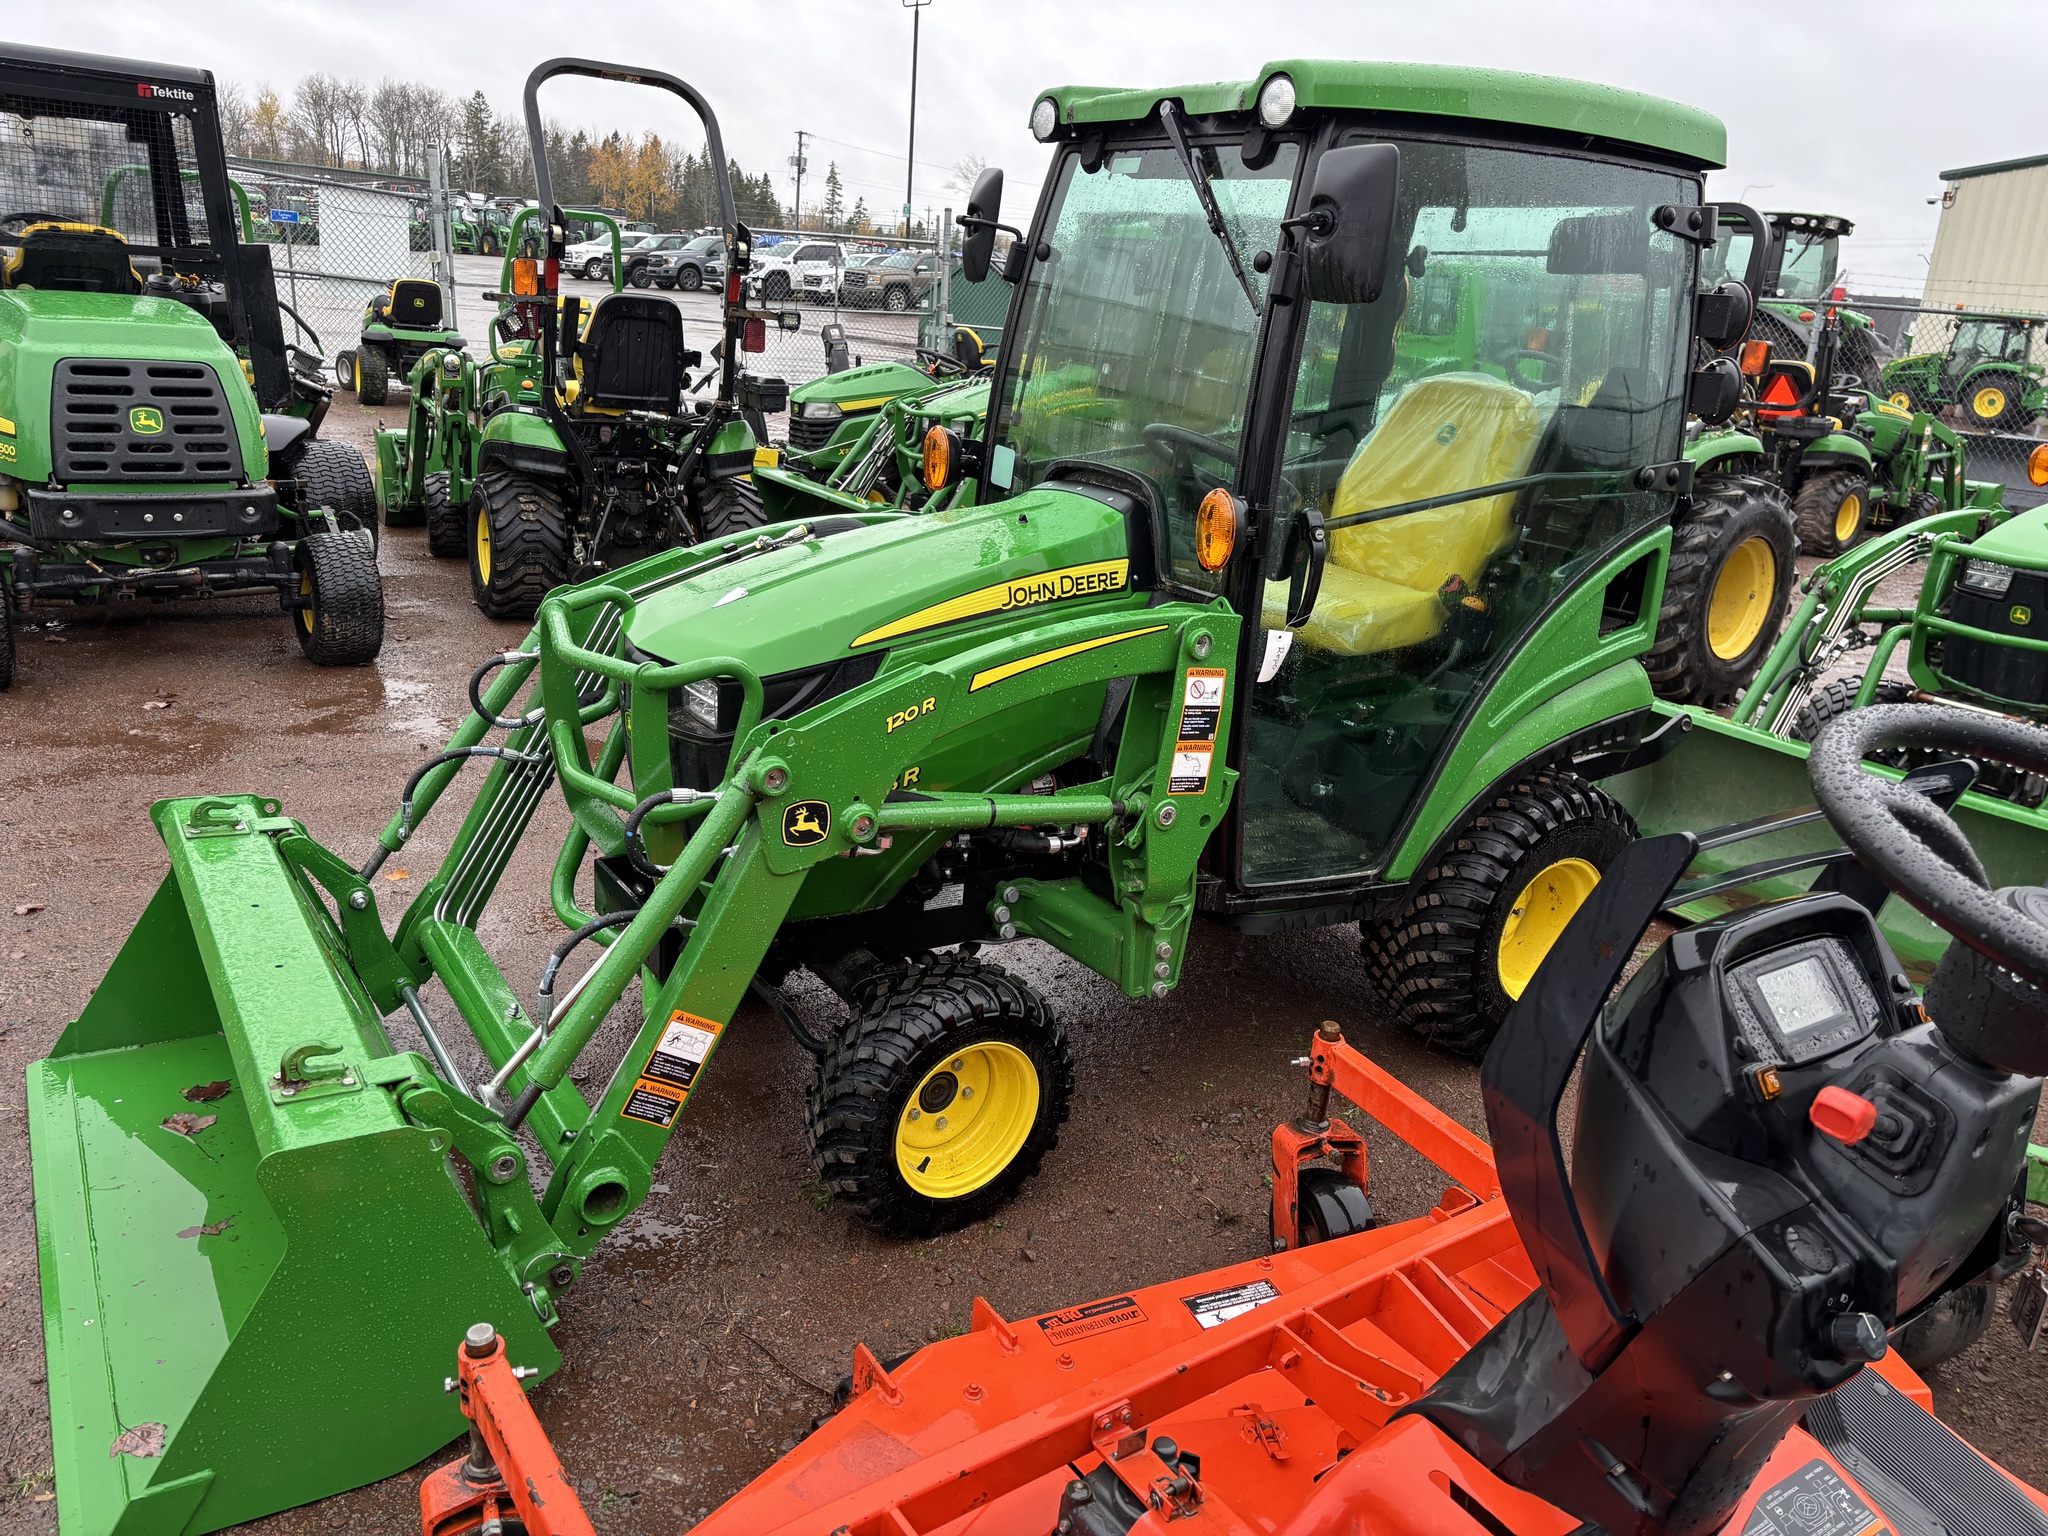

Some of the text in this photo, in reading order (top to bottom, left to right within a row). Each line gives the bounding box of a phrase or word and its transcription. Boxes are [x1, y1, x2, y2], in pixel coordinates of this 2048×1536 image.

[150, 85, 195, 100] Tektite
[1001, 571, 1120, 607] JOHN DEERE
[1195, 669, 1224, 677] WARNING
[685, 1016, 716, 1032] WARNING
[650, 1085, 681, 1099] WARNING
